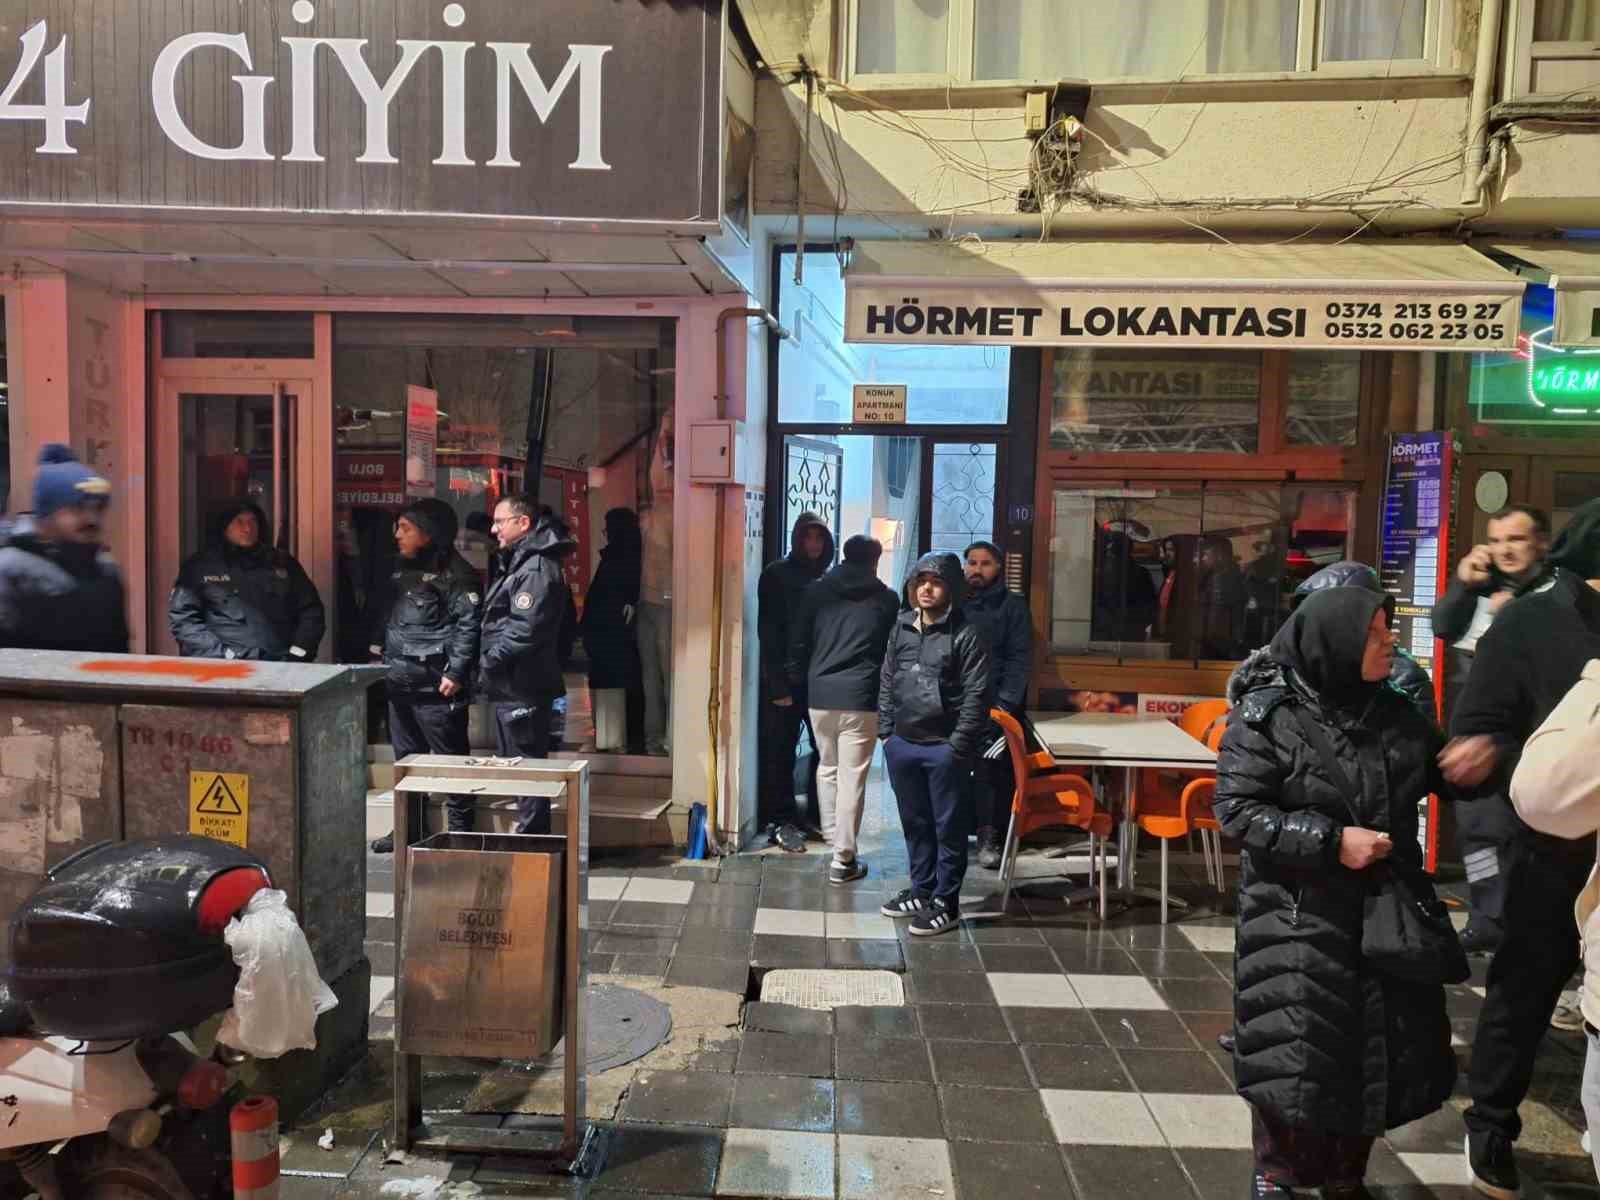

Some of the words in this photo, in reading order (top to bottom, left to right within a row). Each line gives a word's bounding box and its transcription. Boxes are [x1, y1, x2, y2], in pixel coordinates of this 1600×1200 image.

[151, 0, 613, 170] GİYİM
[866, 298, 1042, 337] HÖRMET
[1060, 306, 1307, 338] LOKANTASI
[1326, 302, 1383, 319] 0374
[1394, 303, 1432, 319] 213
[1438, 303, 1467, 320] 69
[1474, 303, 1502, 320] 27
[1325, 322, 1383, 339] 0532
[1389, 323, 1434, 340] 062
[1440, 324, 1468, 340] 23
[1474, 323, 1504, 340] 05
[865, 389, 895, 397] KONUK
[864, 412, 880, 420] NO:
[884, 412, 895, 420] 10
[1015, 507, 1029, 521] 10
